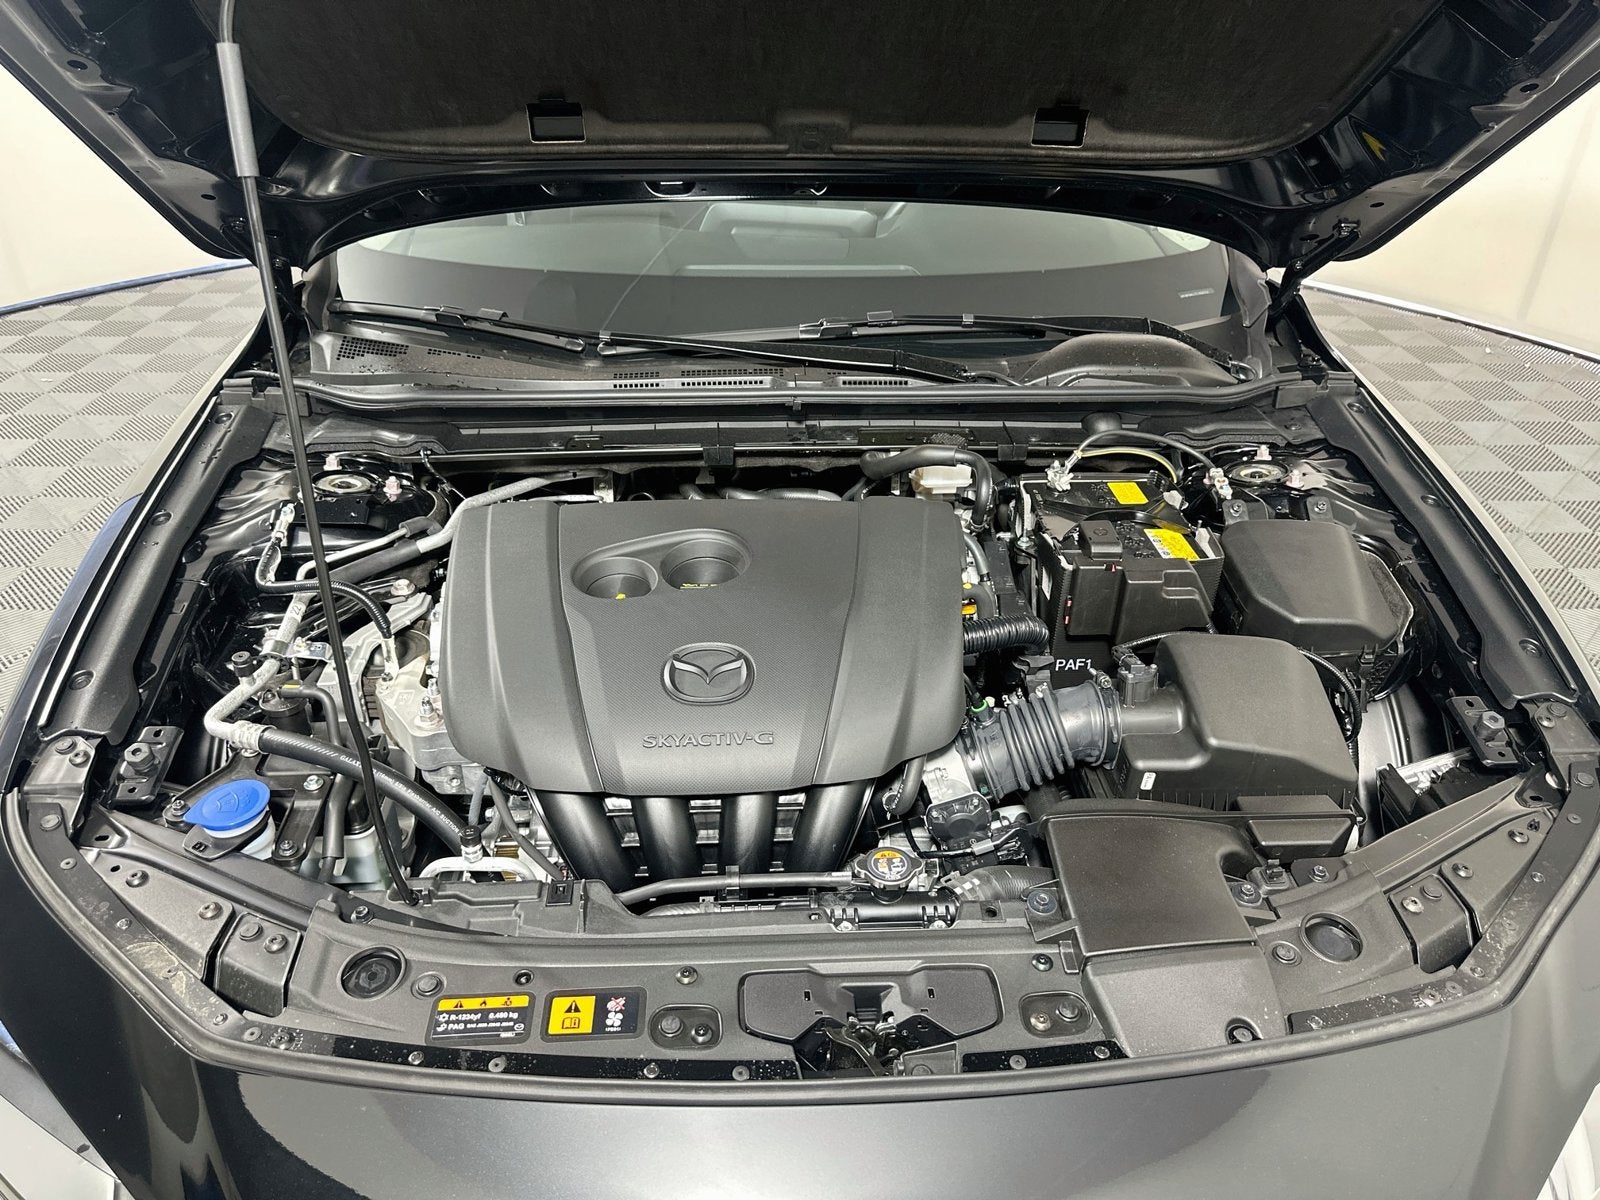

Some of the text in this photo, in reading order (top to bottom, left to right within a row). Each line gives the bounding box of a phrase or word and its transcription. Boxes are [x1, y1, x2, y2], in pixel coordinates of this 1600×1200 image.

[1055, 658, 1092, 671] PAF1
[642, 731, 774, 748] SKYACTIV-G
[340, 755, 362, 768] GALAX
[440, 814, 460, 833] SUCTION
[449, 1013, 482, 1021] R-1234yf
[509, 1011, 519, 1019] kg
